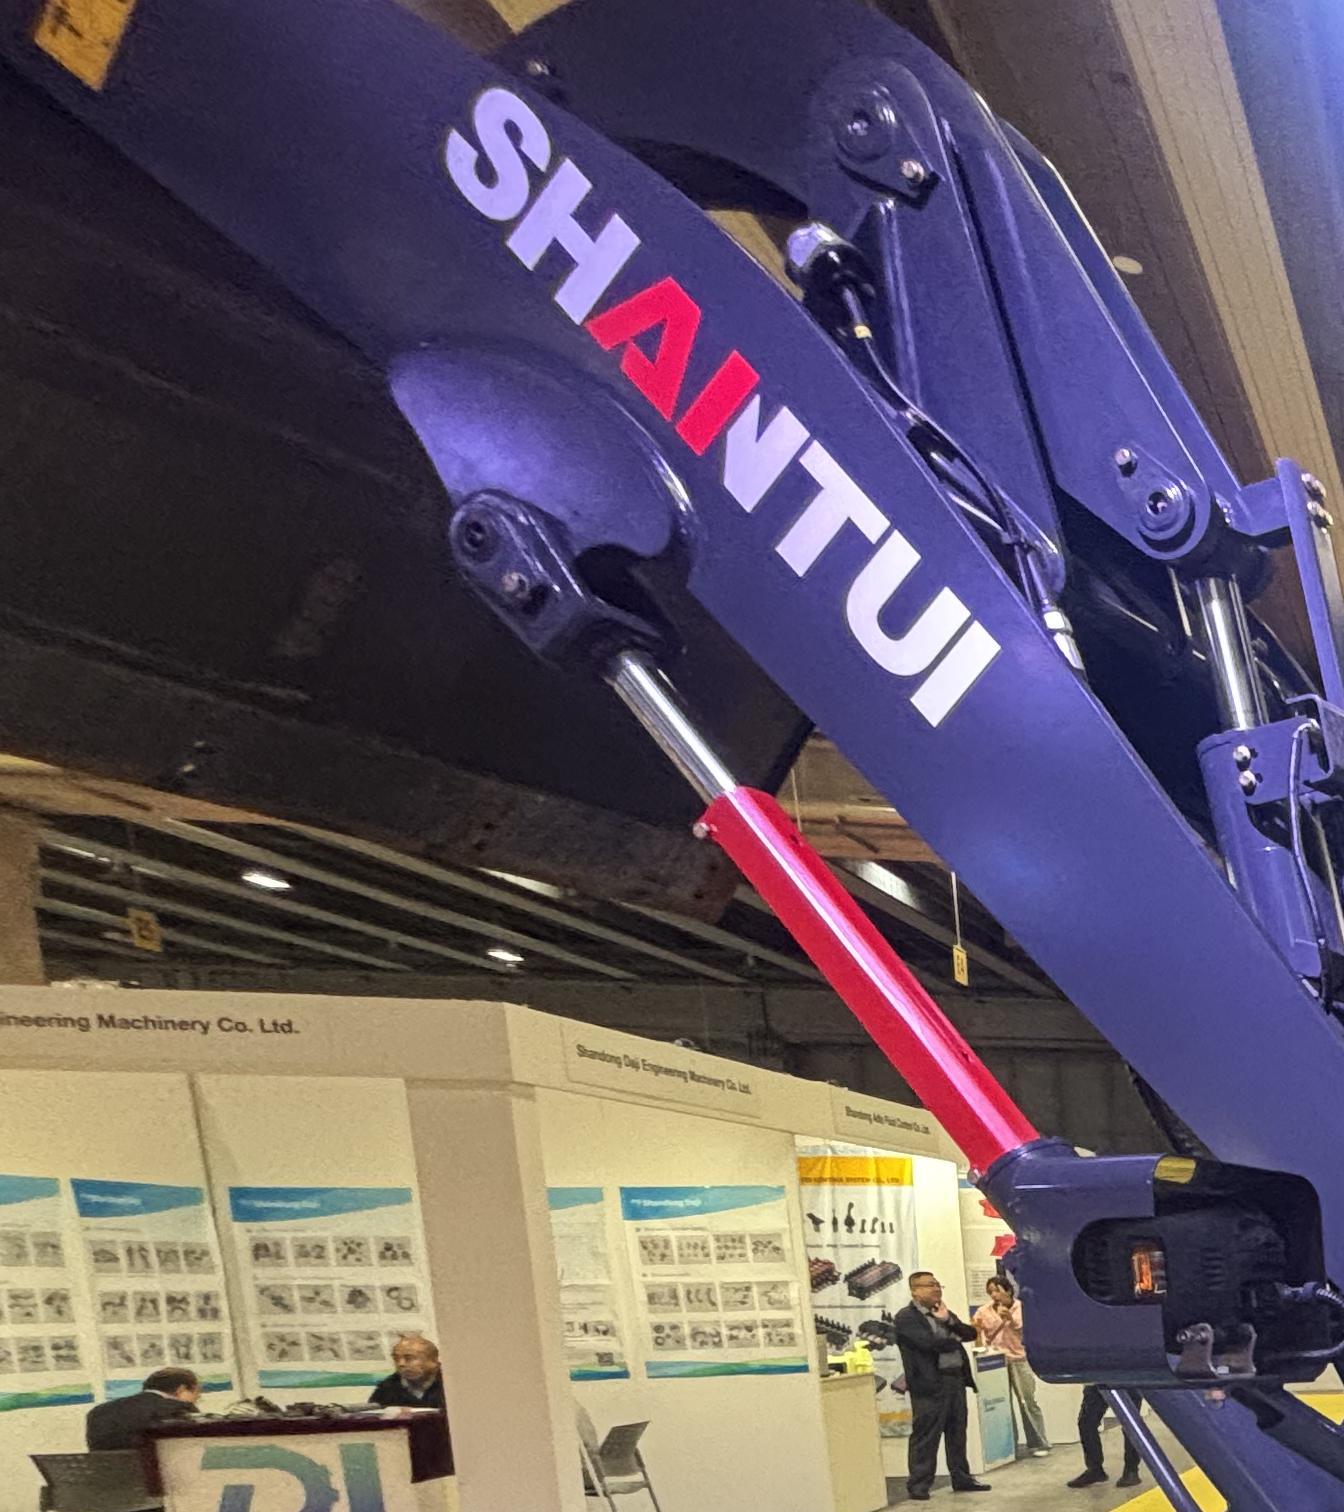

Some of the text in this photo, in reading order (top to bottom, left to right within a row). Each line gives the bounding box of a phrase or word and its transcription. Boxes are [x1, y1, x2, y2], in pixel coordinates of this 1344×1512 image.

[445, 87, 1001, 728] SHANTUI
[97, 1013, 209, 1035] Machinery
[217, 1017, 253, 1033] Co.
[260, 1018, 300, 1034] Ltd.
